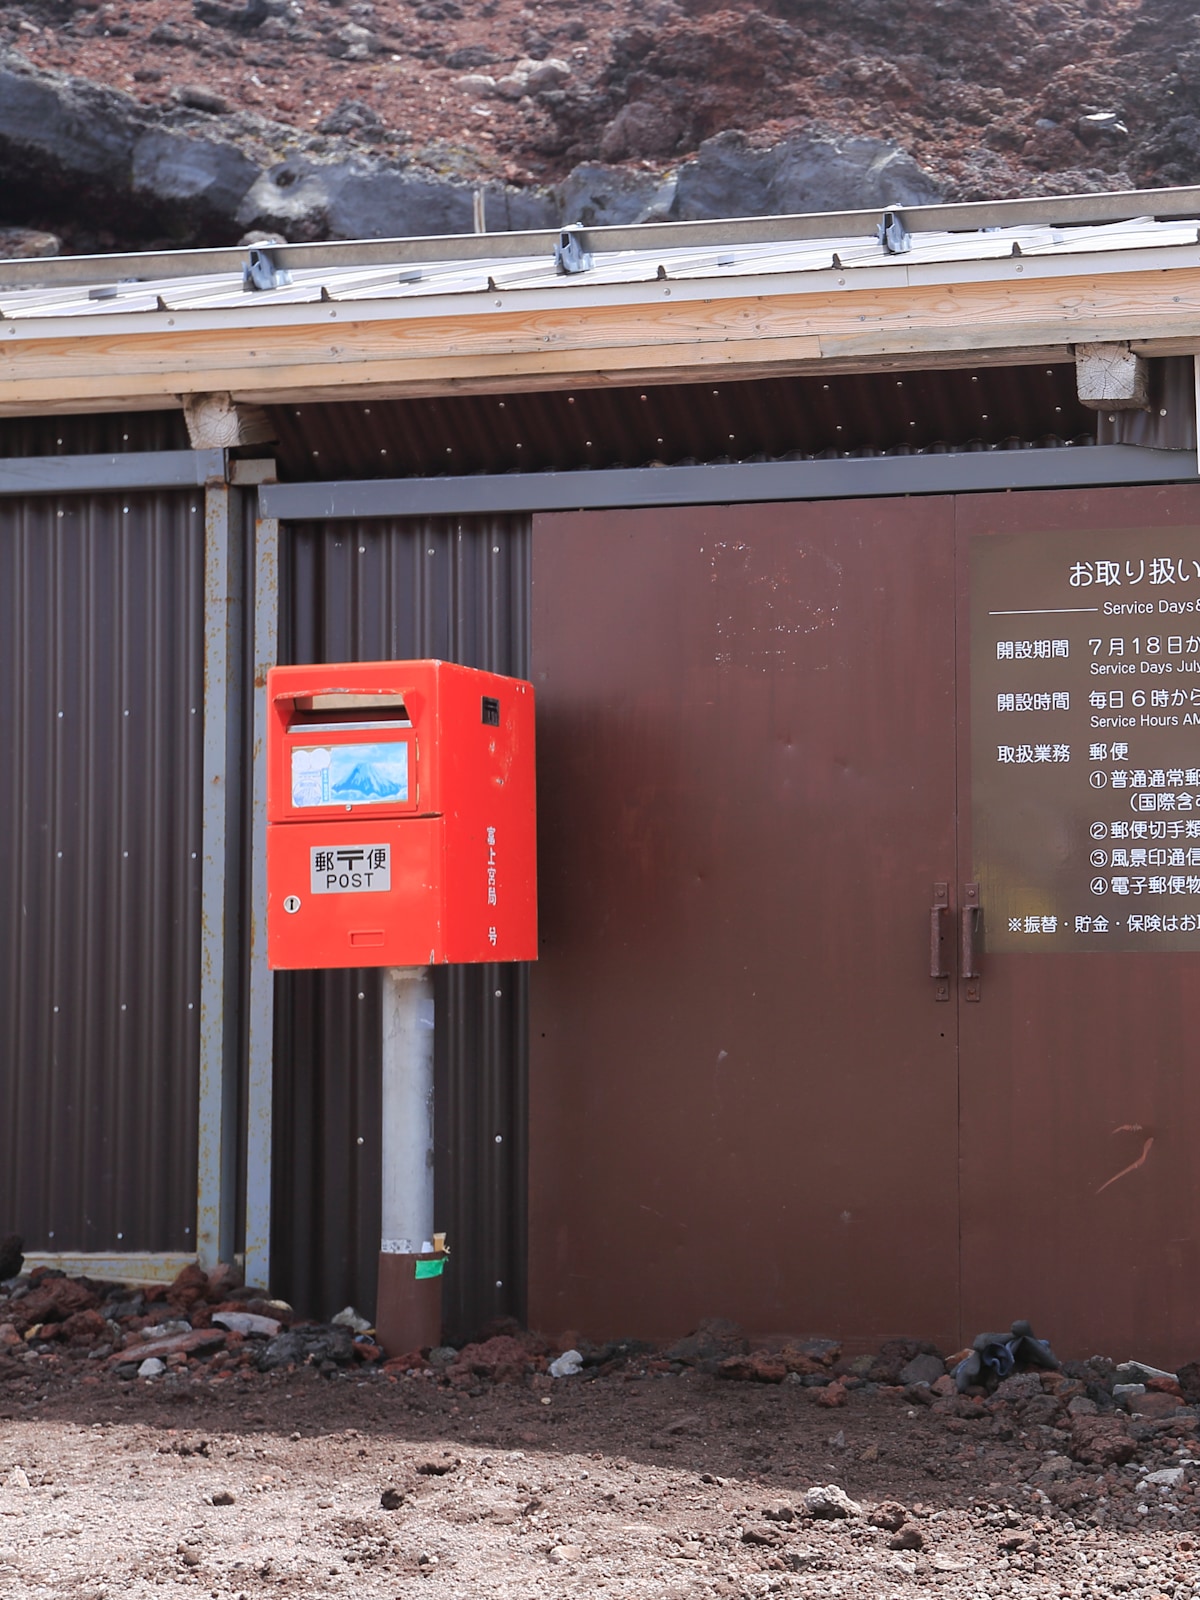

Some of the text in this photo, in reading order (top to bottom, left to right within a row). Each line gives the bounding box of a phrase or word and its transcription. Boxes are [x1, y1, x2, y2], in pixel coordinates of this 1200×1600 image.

[1103, 600, 1154, 616] Service
[996, 639, 1069, 660] 開設期間
[1089, 662, 1136, 675] Service
[1140, 661, 1173, 675] Days
[997, 691, 1070, 713] 開設時間
[1090, 715, 1136, 728] Service
[1140, 713, 1179, 727] Hours
[996, 741, 1129, 764] 取扱業務 郵便
[326, 872, 375, 890] POST
